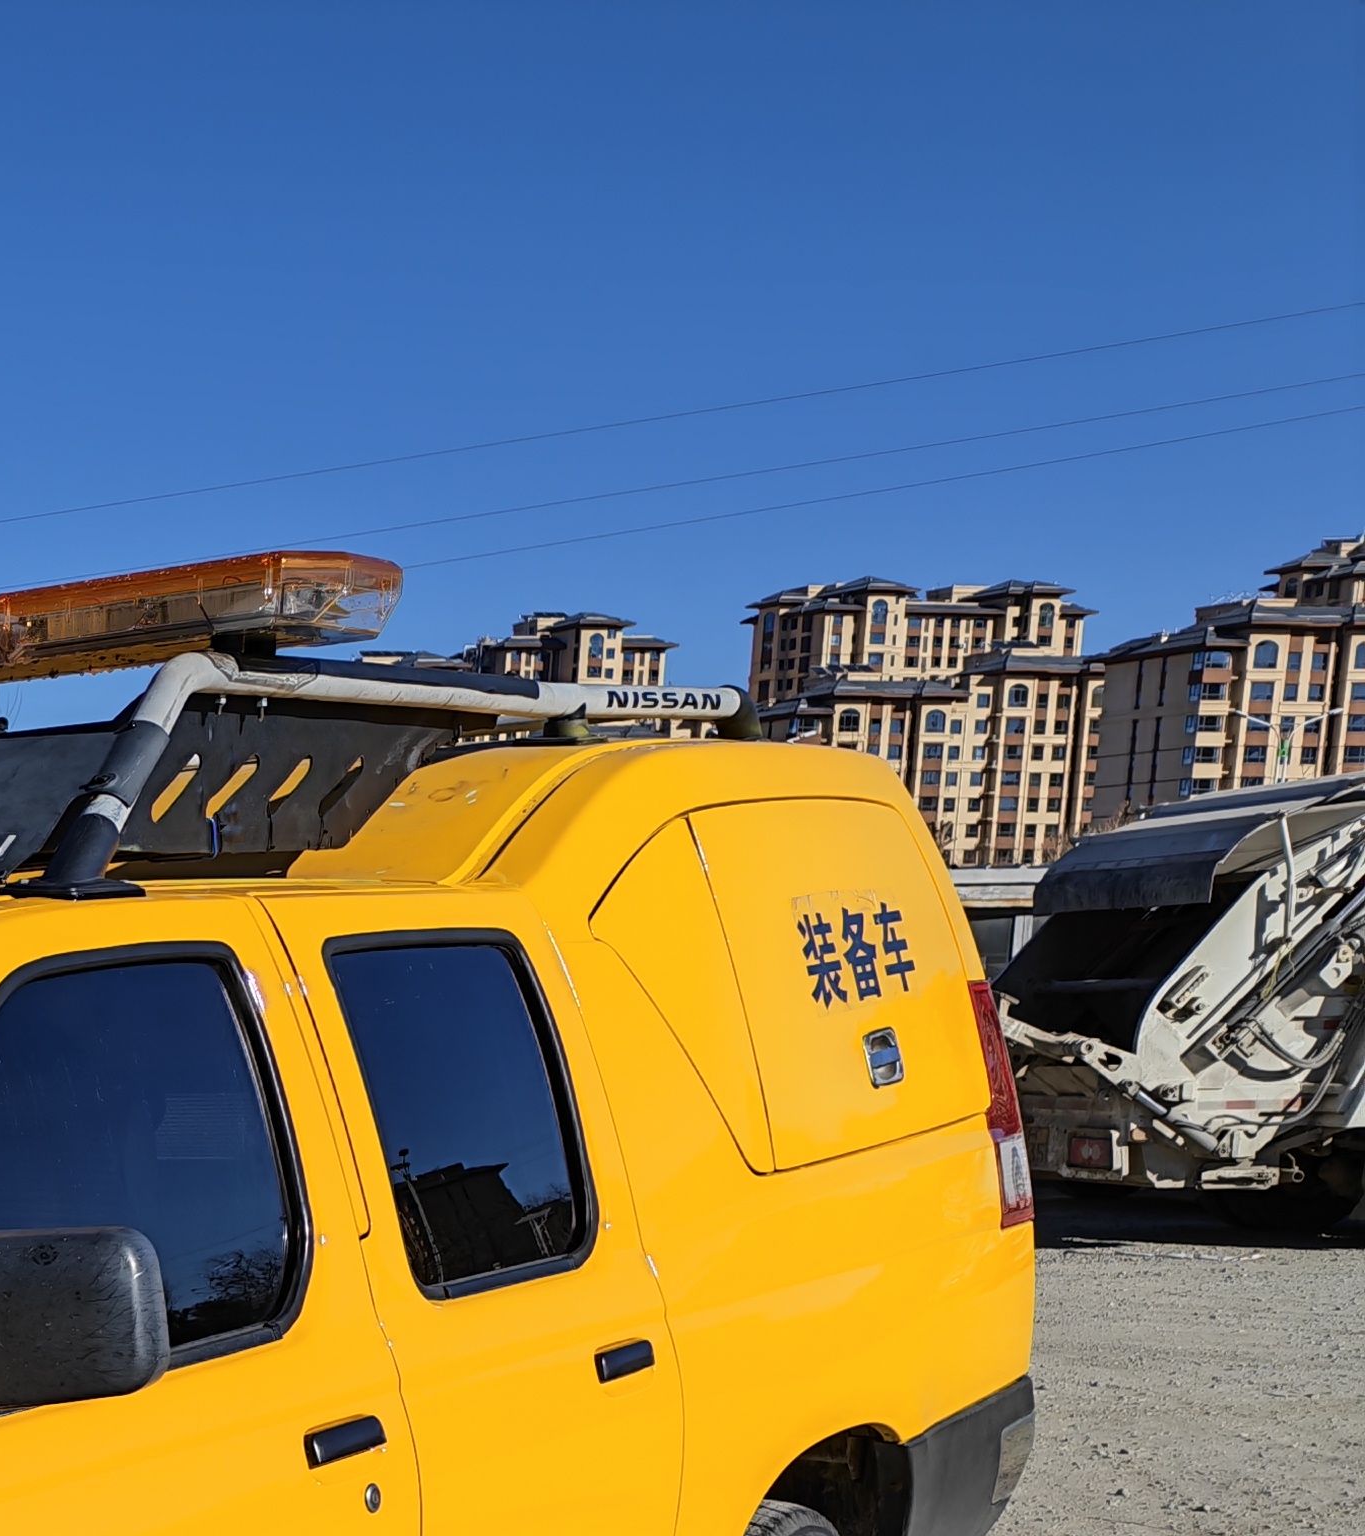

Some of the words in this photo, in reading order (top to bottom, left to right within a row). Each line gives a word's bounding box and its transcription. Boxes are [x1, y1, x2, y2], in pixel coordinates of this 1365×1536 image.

[606, 688, 722, 711] NISSAN
[797, 902, 916, 1010] 装备车
